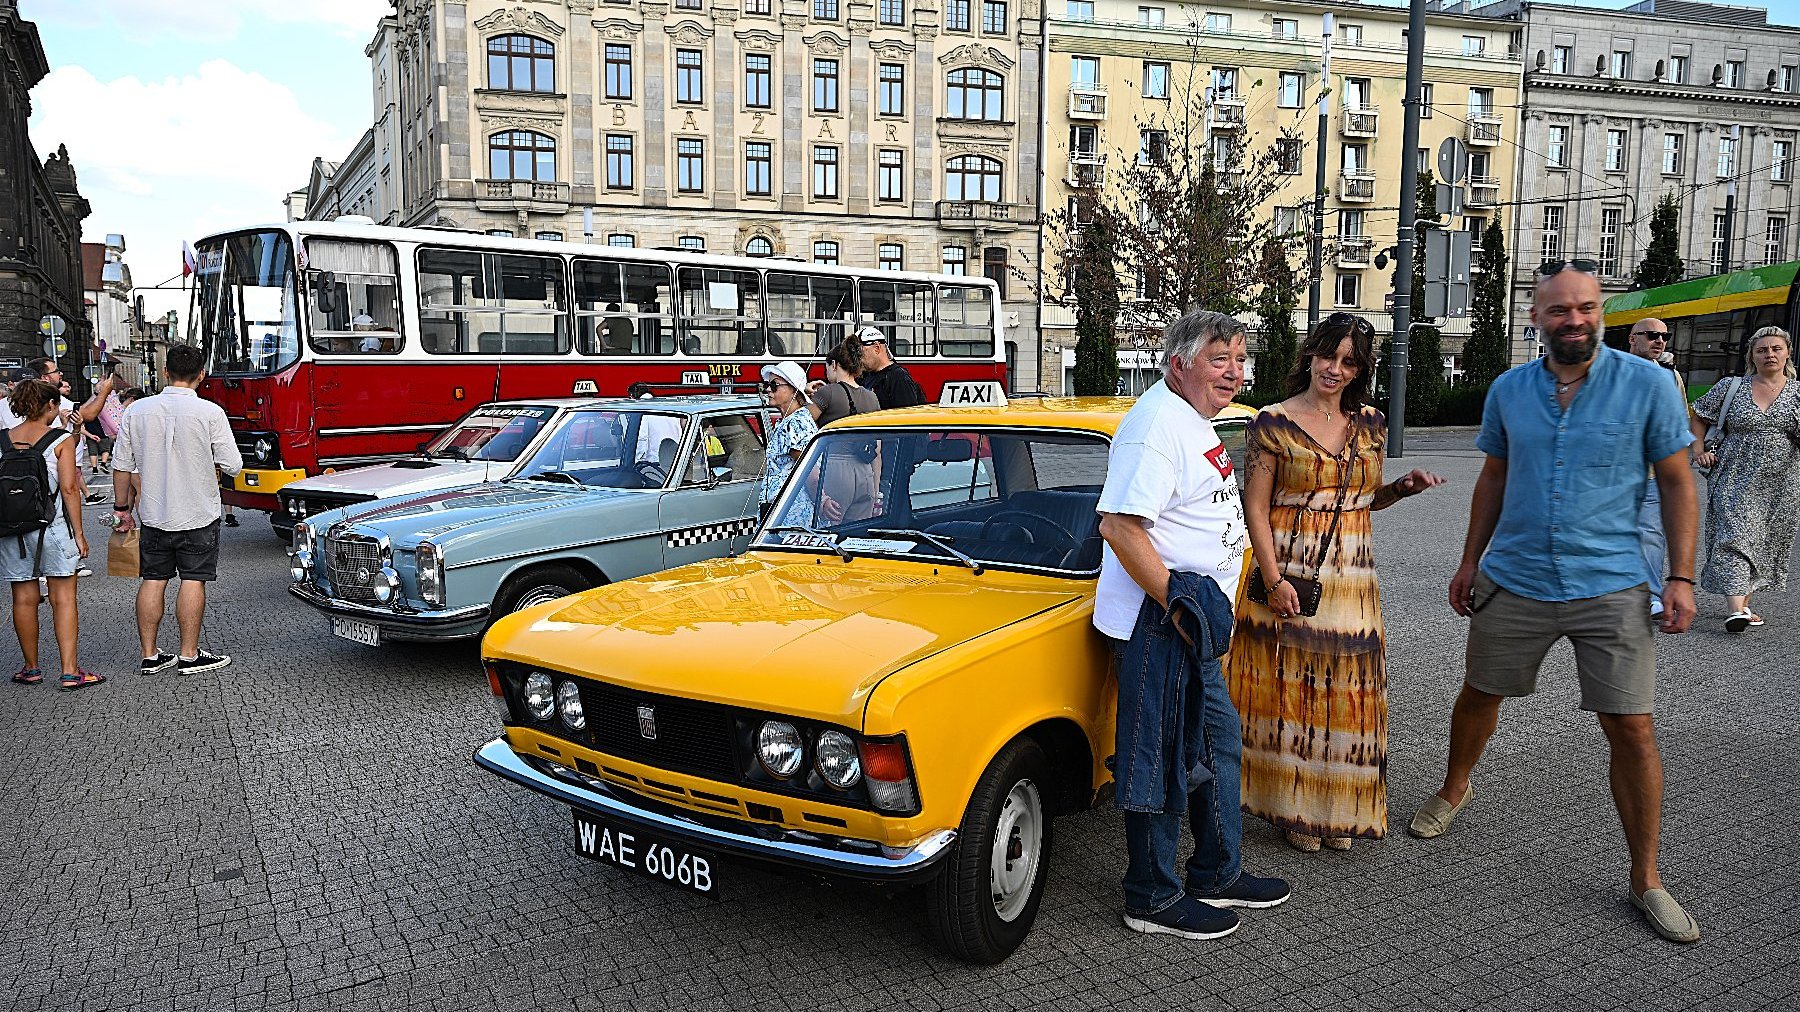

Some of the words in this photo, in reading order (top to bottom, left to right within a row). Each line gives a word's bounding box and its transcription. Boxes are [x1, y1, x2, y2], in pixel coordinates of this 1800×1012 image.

[709, 364, 742, 377] MPK
[576, 382, 592, 391] TAXI
[684, 374, 703, 384] TAXI
[947, 384, 992, 404] TAXI
[336, 618, 347, 636] PO
[578, 819, 636, 868] WAE
[645, 843, 712, 892] 606B
